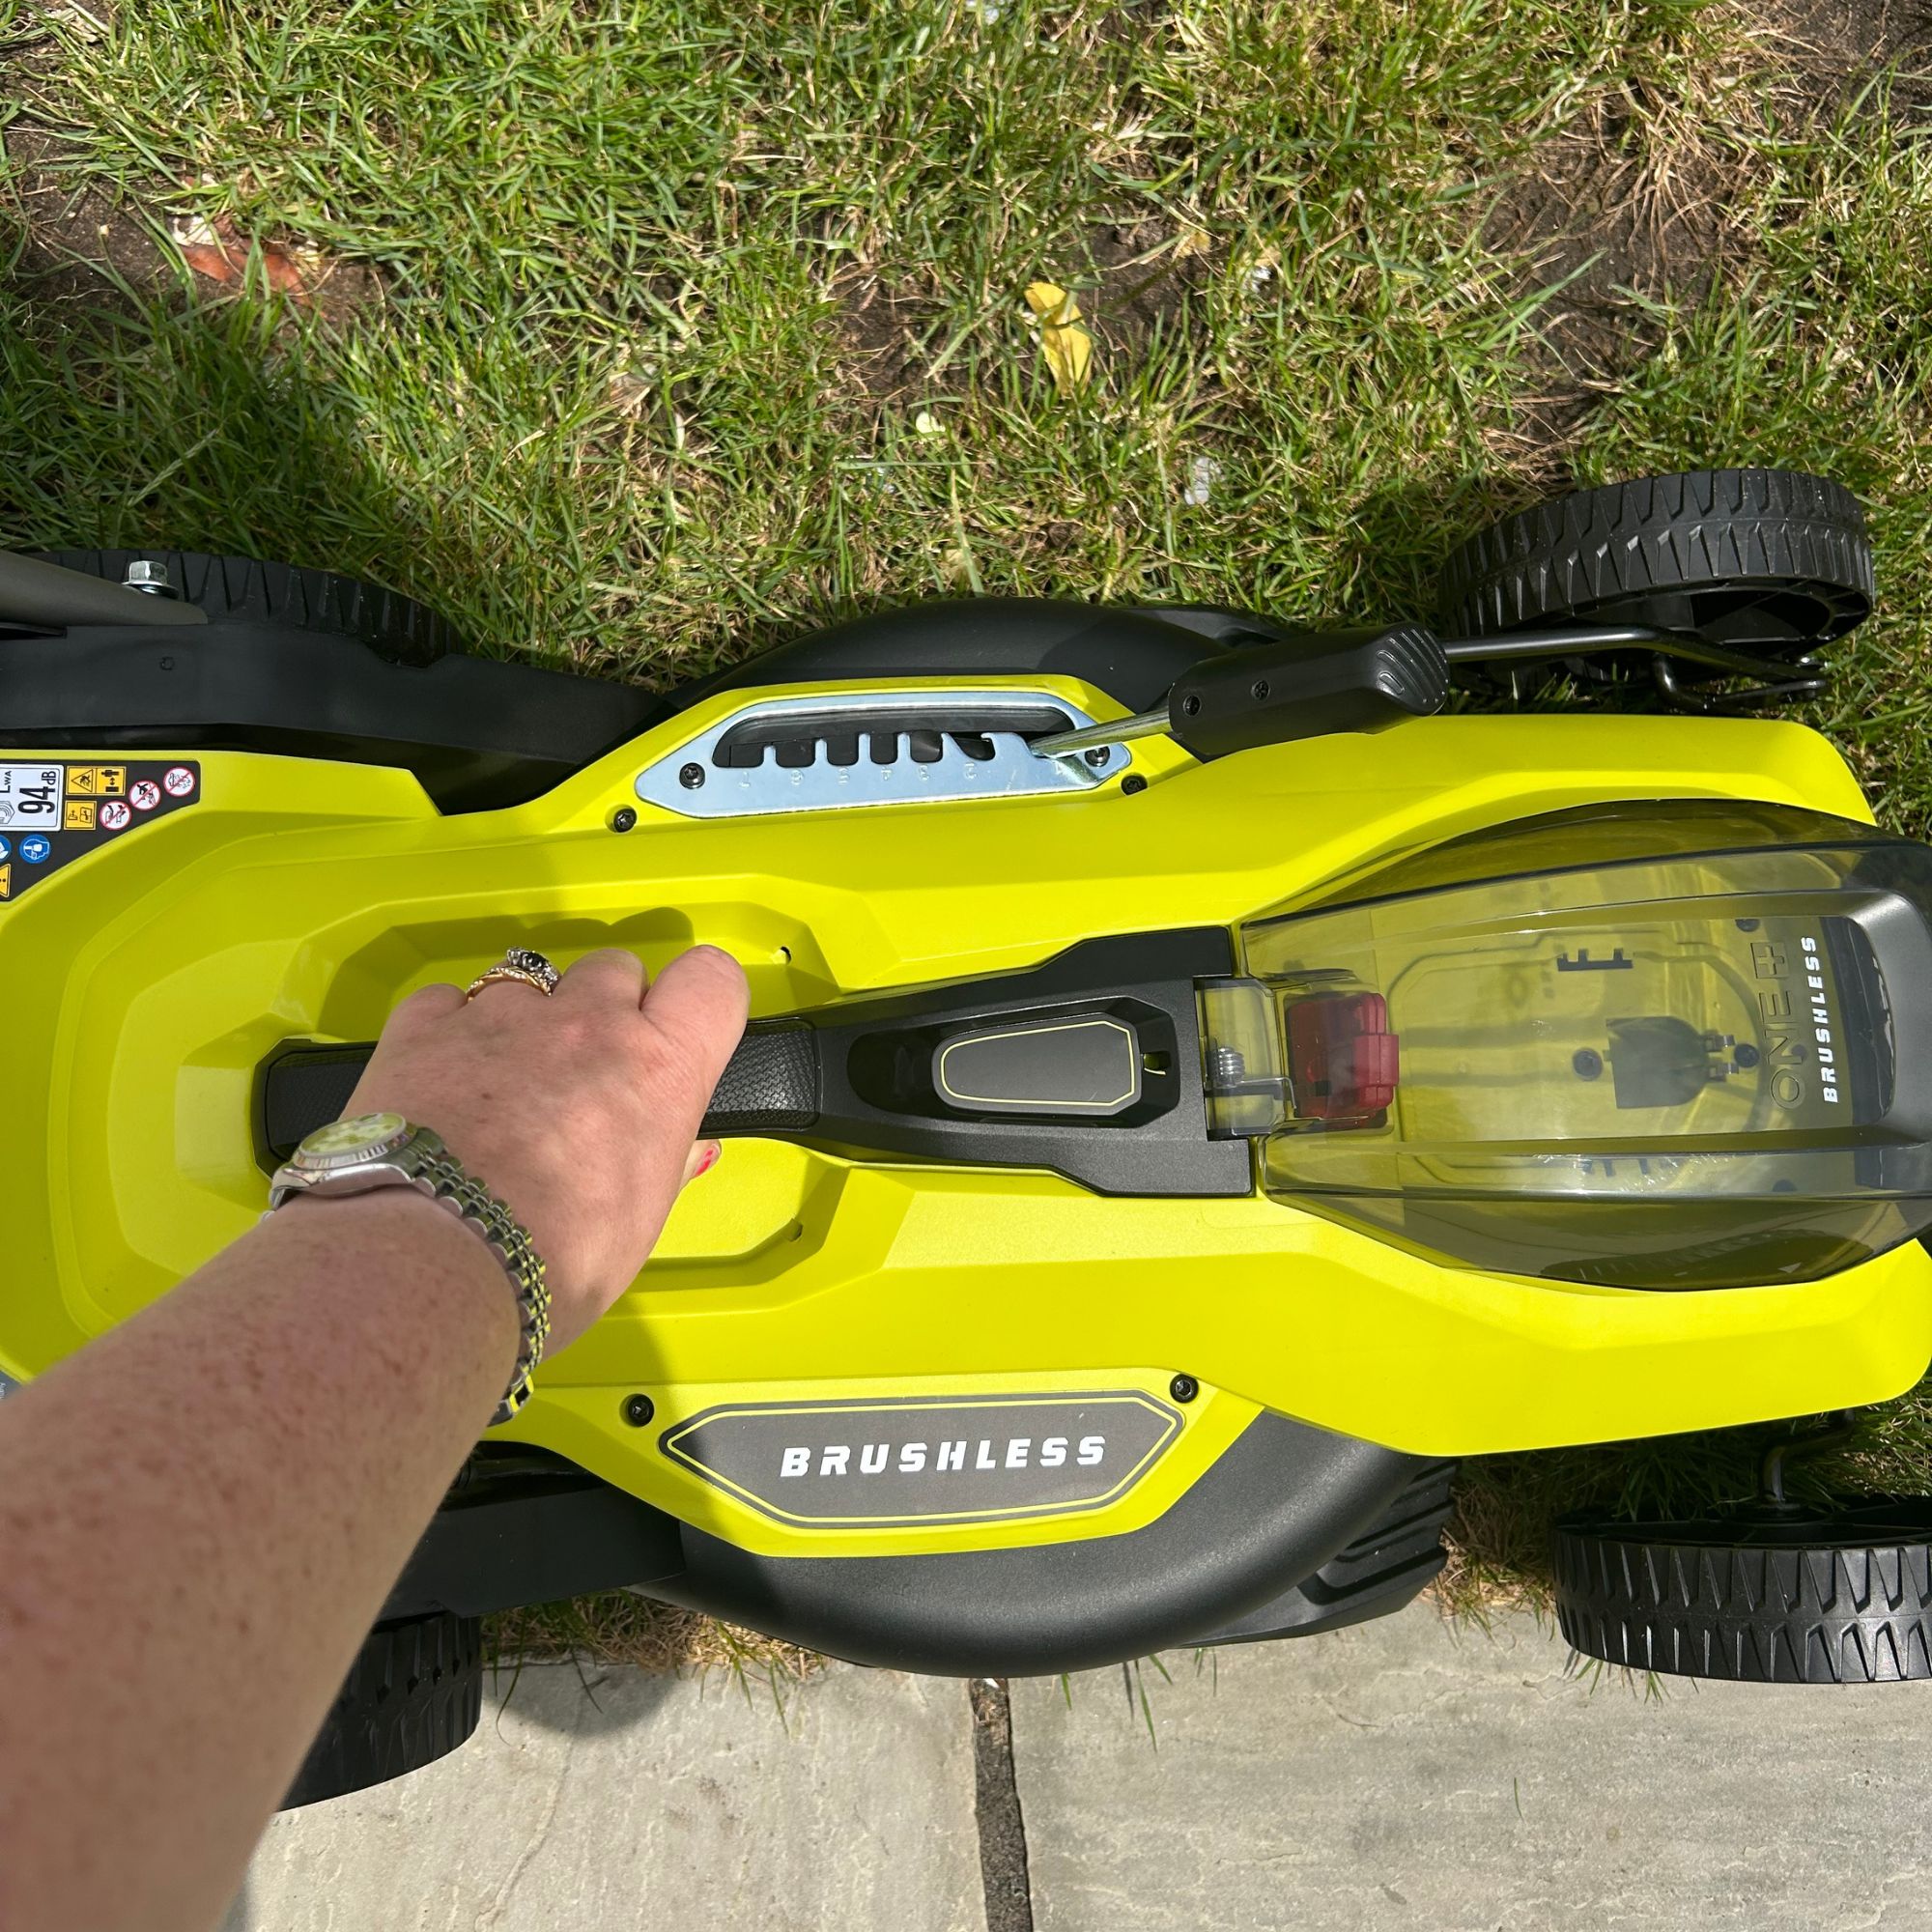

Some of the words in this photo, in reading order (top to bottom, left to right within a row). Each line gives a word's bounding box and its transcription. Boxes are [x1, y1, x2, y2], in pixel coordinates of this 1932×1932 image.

[17, 786, 56, 814] 94
[42, 770, 57, 785] dB
[1801, 936, 1839, 1103] BRUSHLESS
[780, 1435, 1107, 1478] BRUSHLESS
